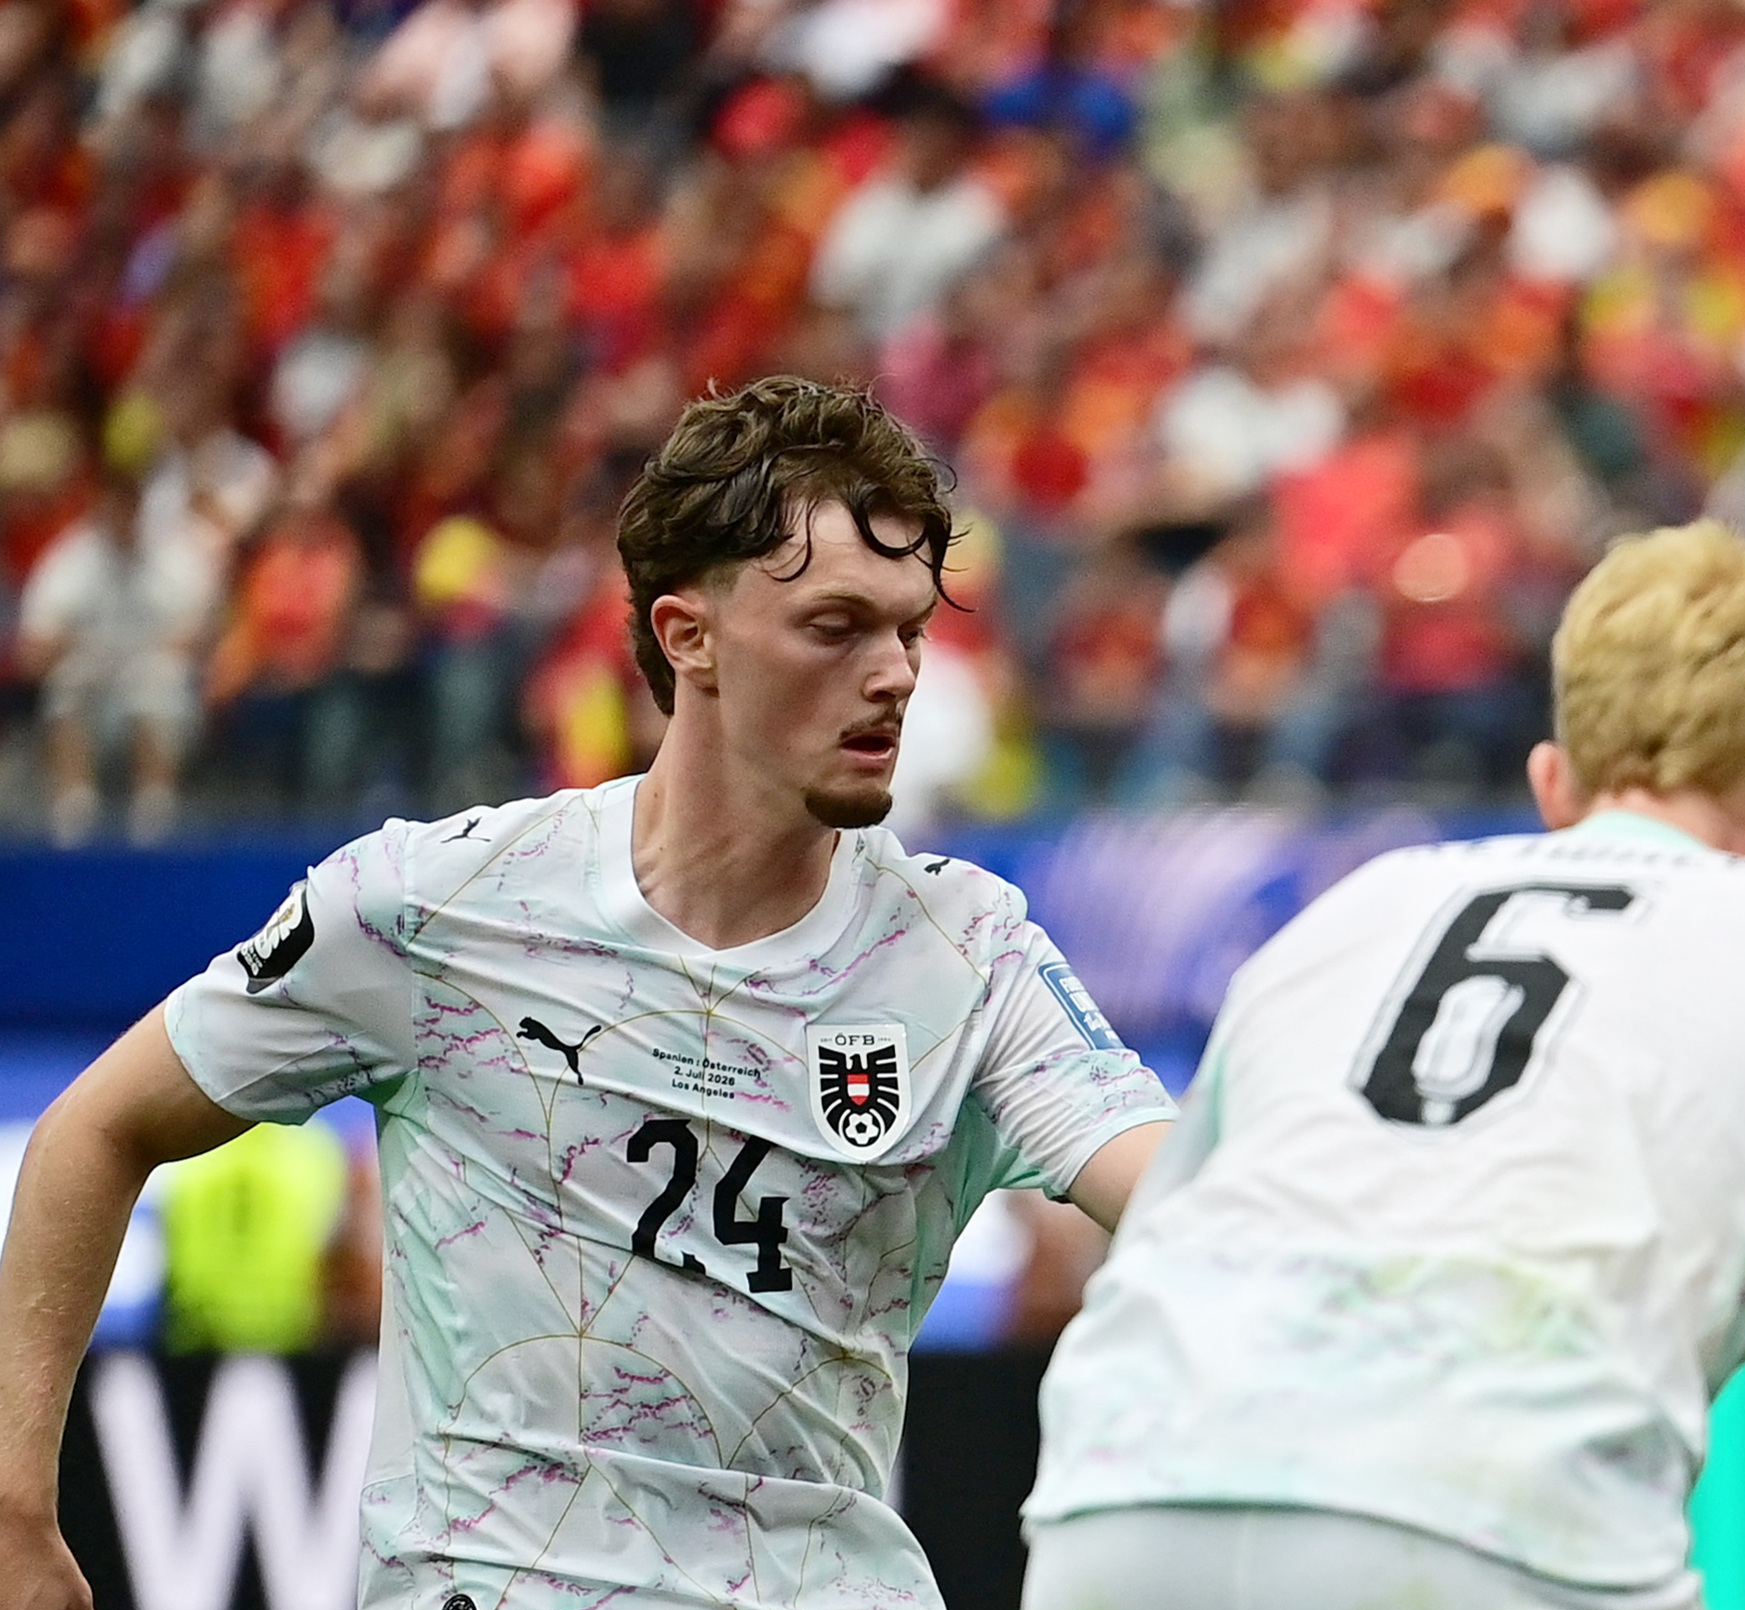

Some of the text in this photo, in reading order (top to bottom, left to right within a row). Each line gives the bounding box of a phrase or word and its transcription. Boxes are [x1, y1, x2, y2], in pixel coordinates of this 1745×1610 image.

[1353, 880, 1638, 1127] 6
[652, 1048, 694, 1066] Spanien
[671, 1078, 735, 1099] Los Angeles
[685, 1069, 705, 1081] Juli
[707, 1072, 735, 1087] 2026
[626, 1118, 793, 1293] 24
